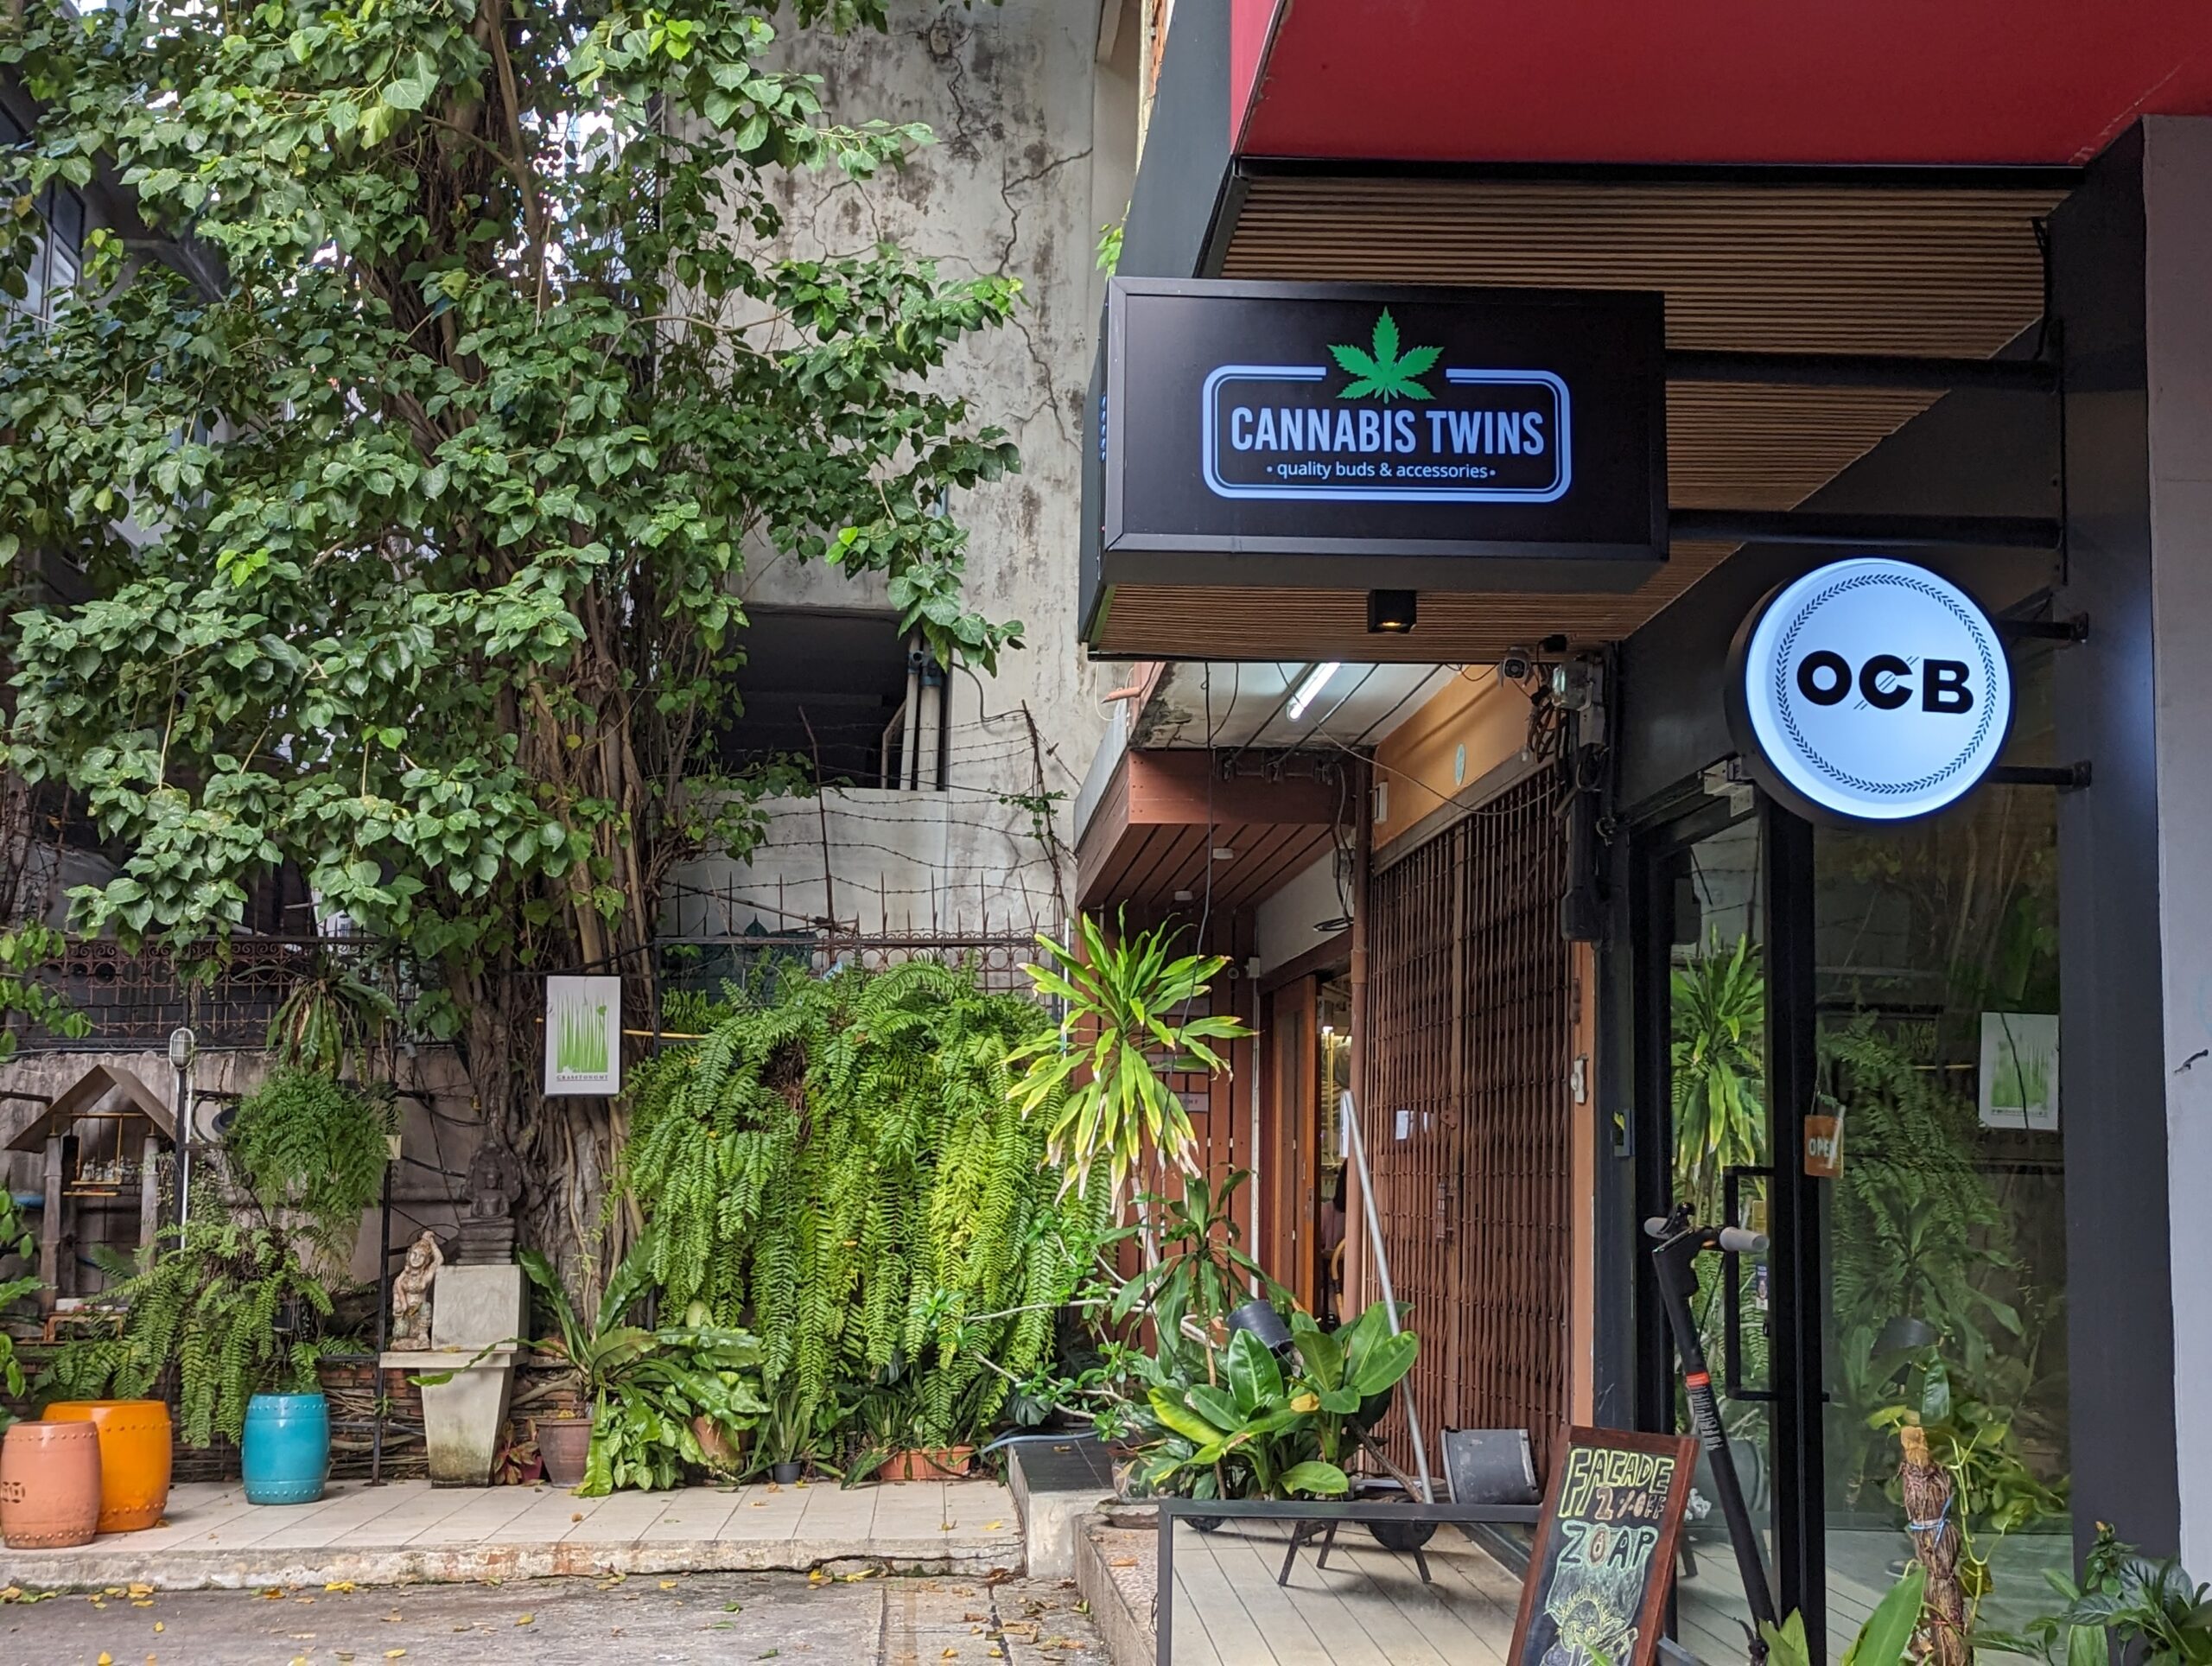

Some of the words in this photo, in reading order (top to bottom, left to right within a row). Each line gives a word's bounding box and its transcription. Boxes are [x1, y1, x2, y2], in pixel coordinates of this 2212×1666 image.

[1230, 407, 1416, 454] CANNABIS
[1426, 410, 1545, 455] TWINS
[1276, 461, 1332, 480] quality
[1335, 461, 1375, 477] buds
[1380, 462, 1393, 478] &
[1396, 463, 1488, 479] accessories
[1797, 650, 1974, 715] OCB
[1558, 1448, 1675, 1518] FACADE
